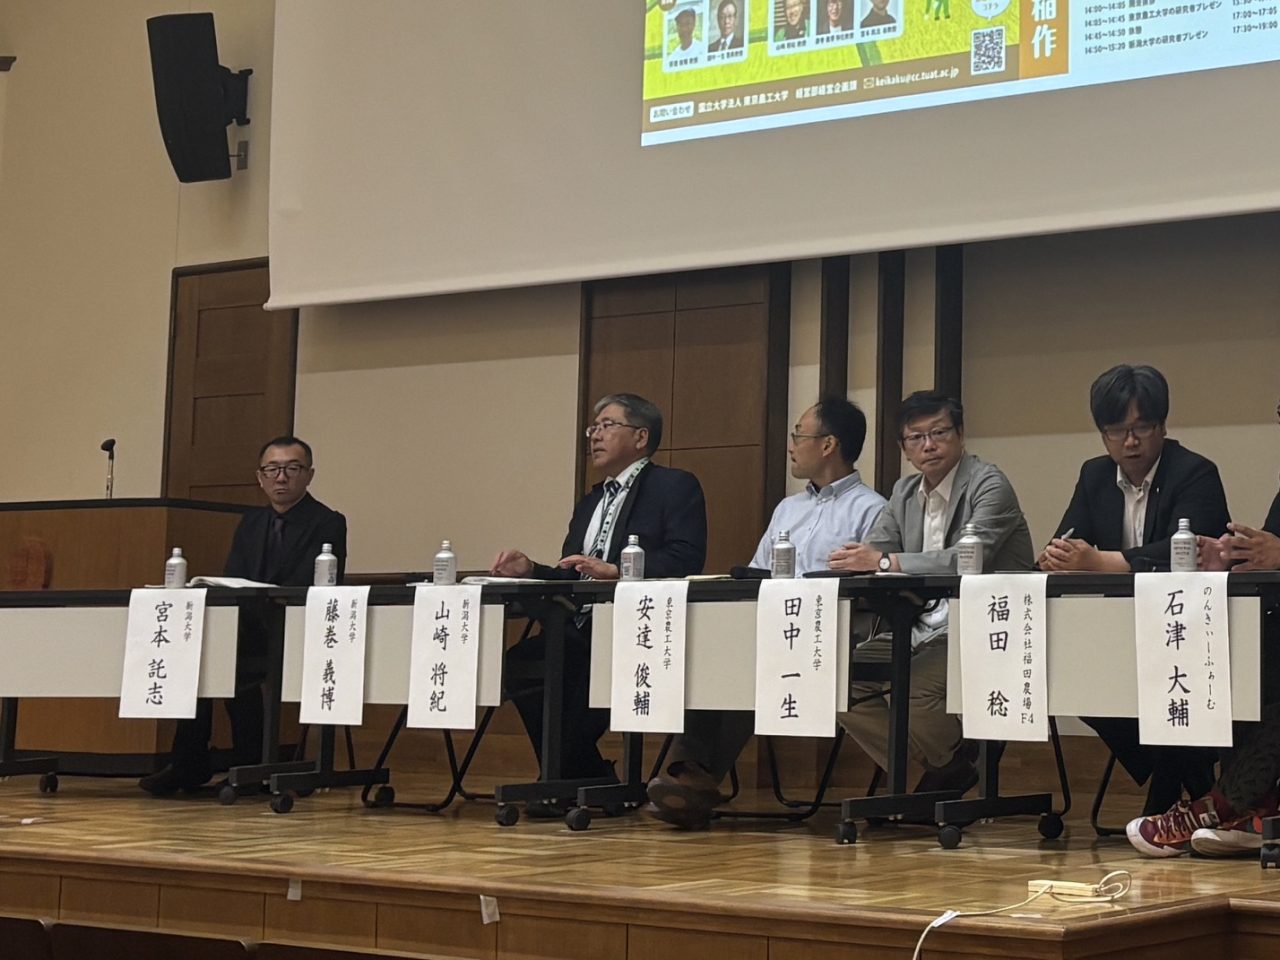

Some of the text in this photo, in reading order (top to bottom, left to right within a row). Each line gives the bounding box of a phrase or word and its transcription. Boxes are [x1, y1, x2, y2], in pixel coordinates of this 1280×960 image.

[150, 601, 174, 649] 宮本
[182, 600, 195, 642] 新潟大学
[347, 598, 359, 644] 新潟大学
[459, 598, 471, 644] 新潟大学
[663, 596, 675, 671] 東京農工大学
[782, 596, 804, 652] 田中
[812, 594, 824, 672] 東京農工大学
[986, 594, 1011, 653] 福田
[1163, 589, 1188, 652] 石津
[145, 658, 168, 706] 託志
[320, 598, 341, 712] 藤巻 義博
[428, 600, 452, 713] 山崎 将紀
[631, 595, 656, 717] 安達 俊輔
[779, 671, 802, 721] 一生
[1166, 664, 1192, 729] 大輔
